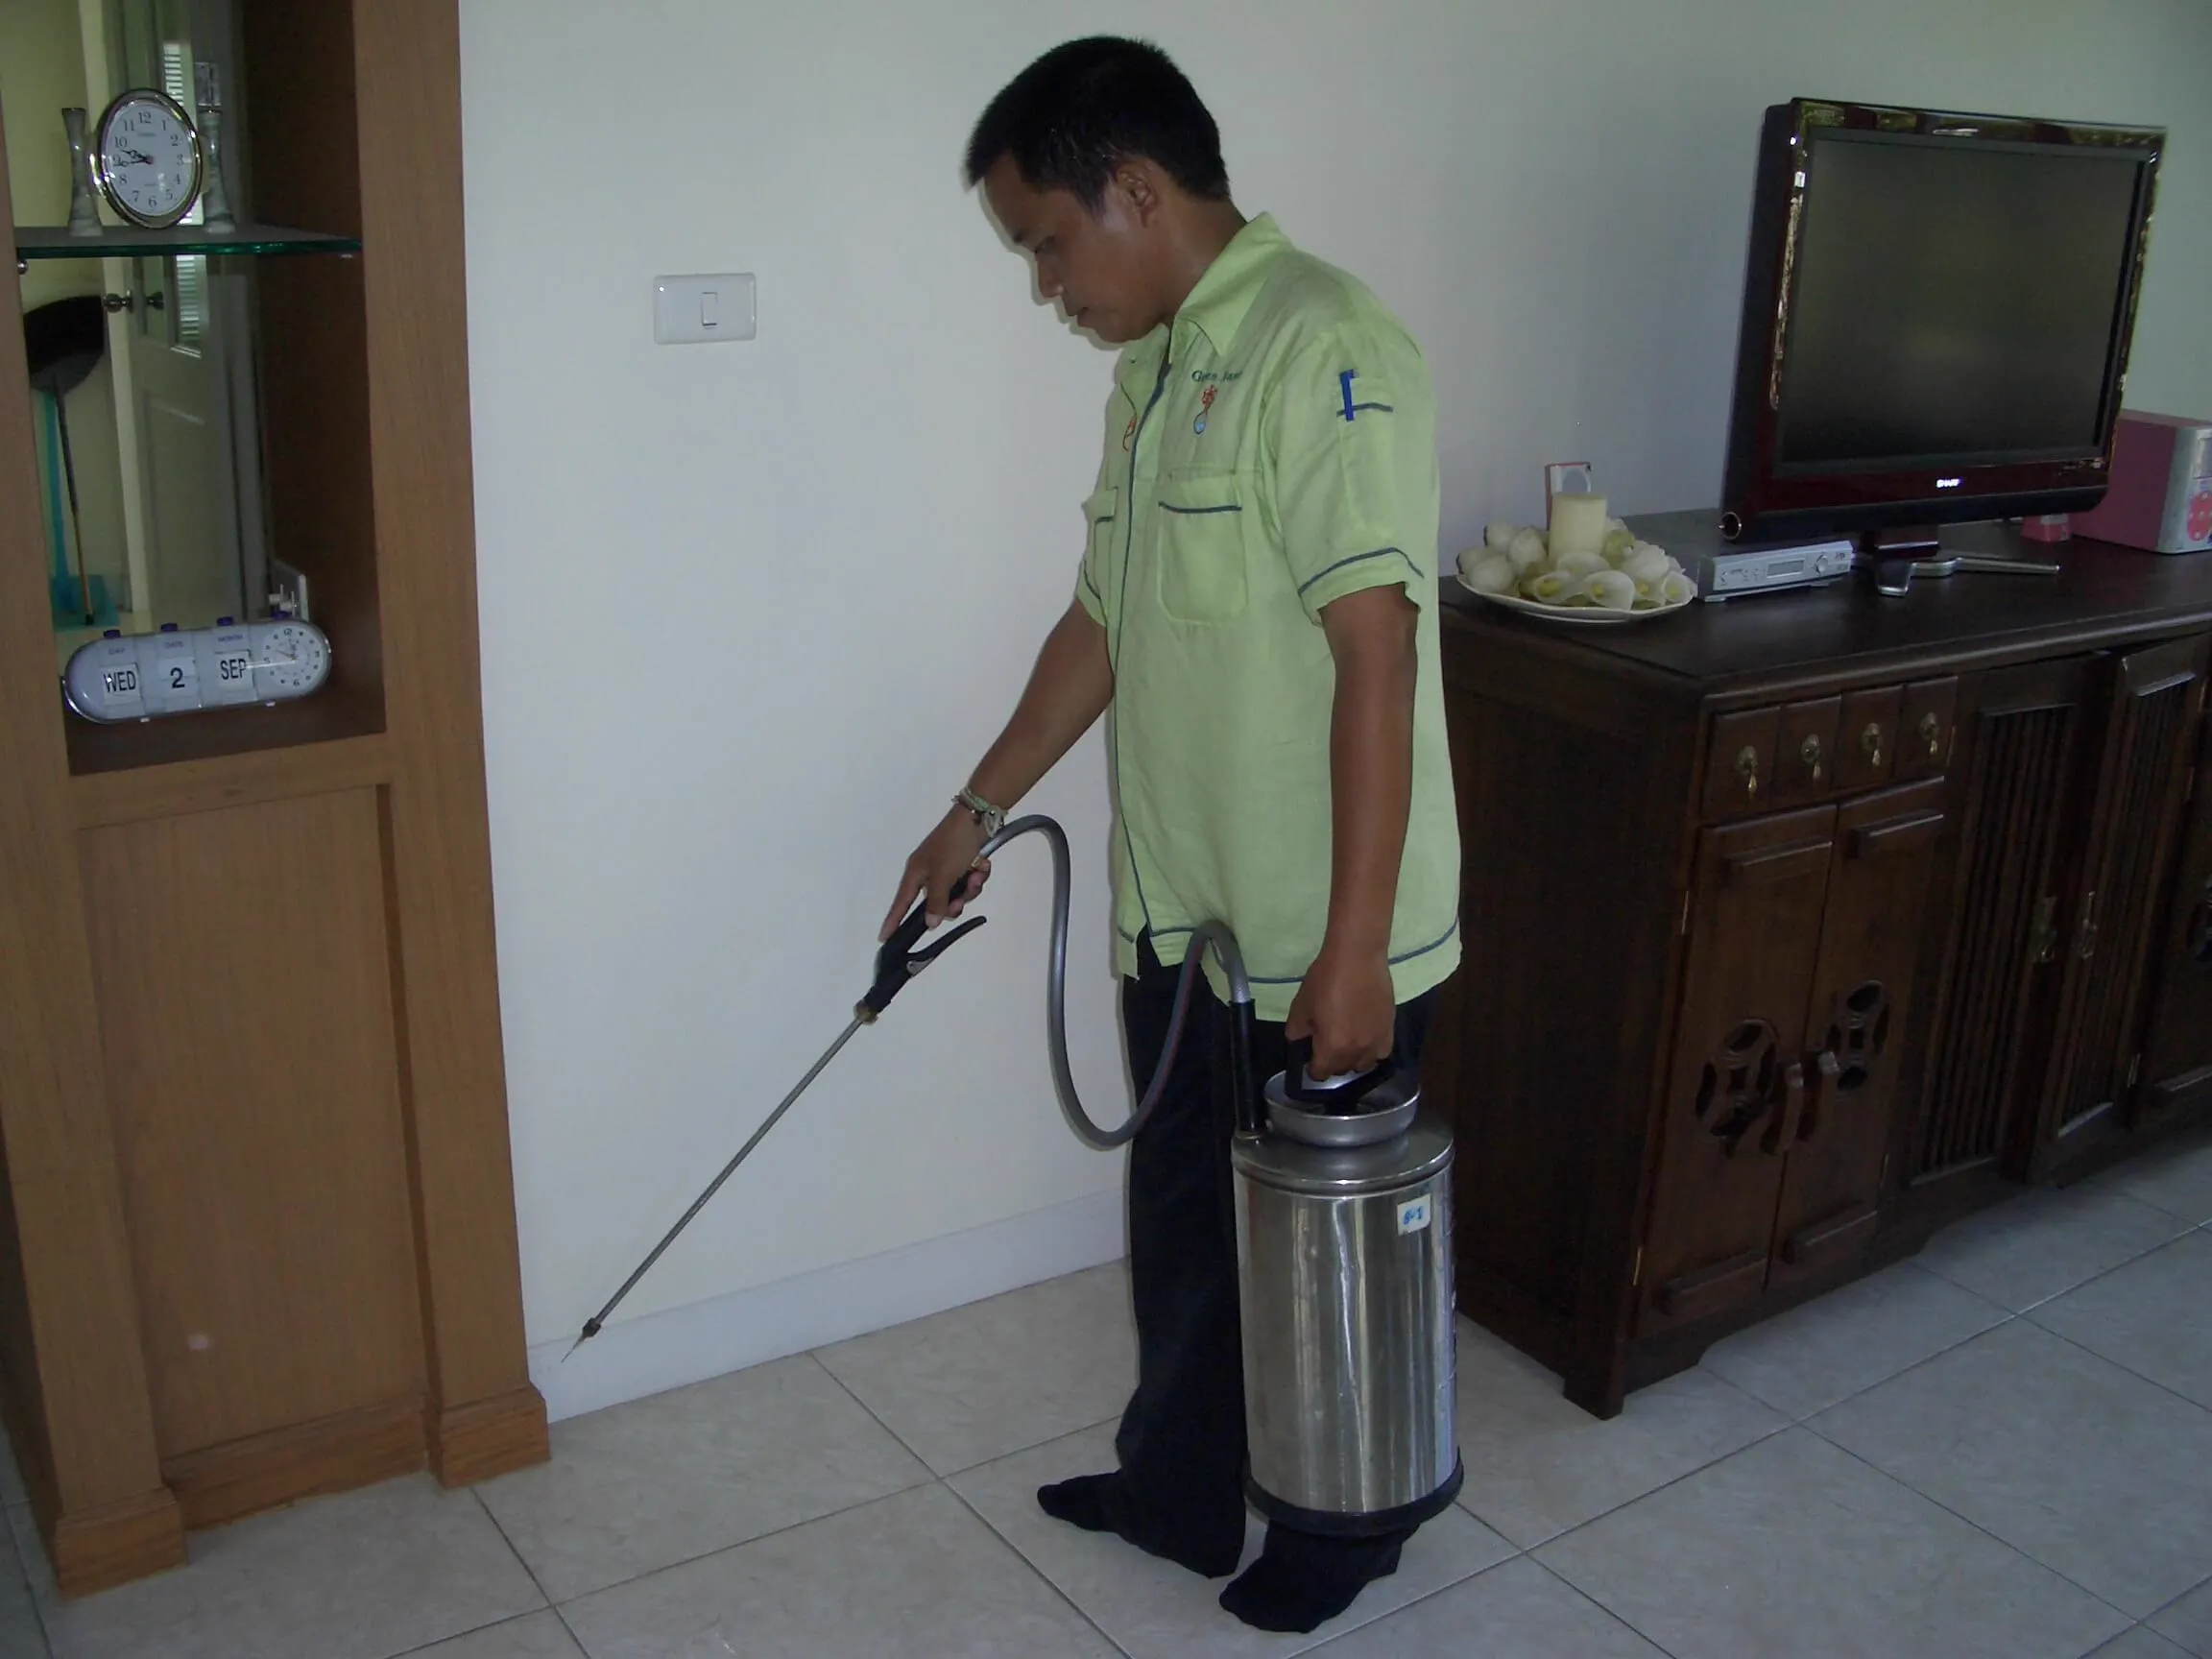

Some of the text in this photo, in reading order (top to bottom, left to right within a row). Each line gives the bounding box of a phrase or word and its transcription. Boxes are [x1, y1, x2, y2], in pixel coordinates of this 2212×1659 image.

[138, 110, 152, 124] 12
[123, 119, 134, 132] 11
[161, 119, 167, 132] 1
[114, 136, 128, 148] 10
[170, 133, 179, 147] 2
[177, 153, 183, 166] 3
[119, 174, 127, 185] 8
[172, 173, 180, 185] 4
[132, 190, 140, 203] 7
[165, 188, 173, 201] 5
[148, 195, 157, 208] 6
[220, 659, 247, 680] SEP
[103, 670, 136, 693] WED
[170, 667, 185, 689] 2
